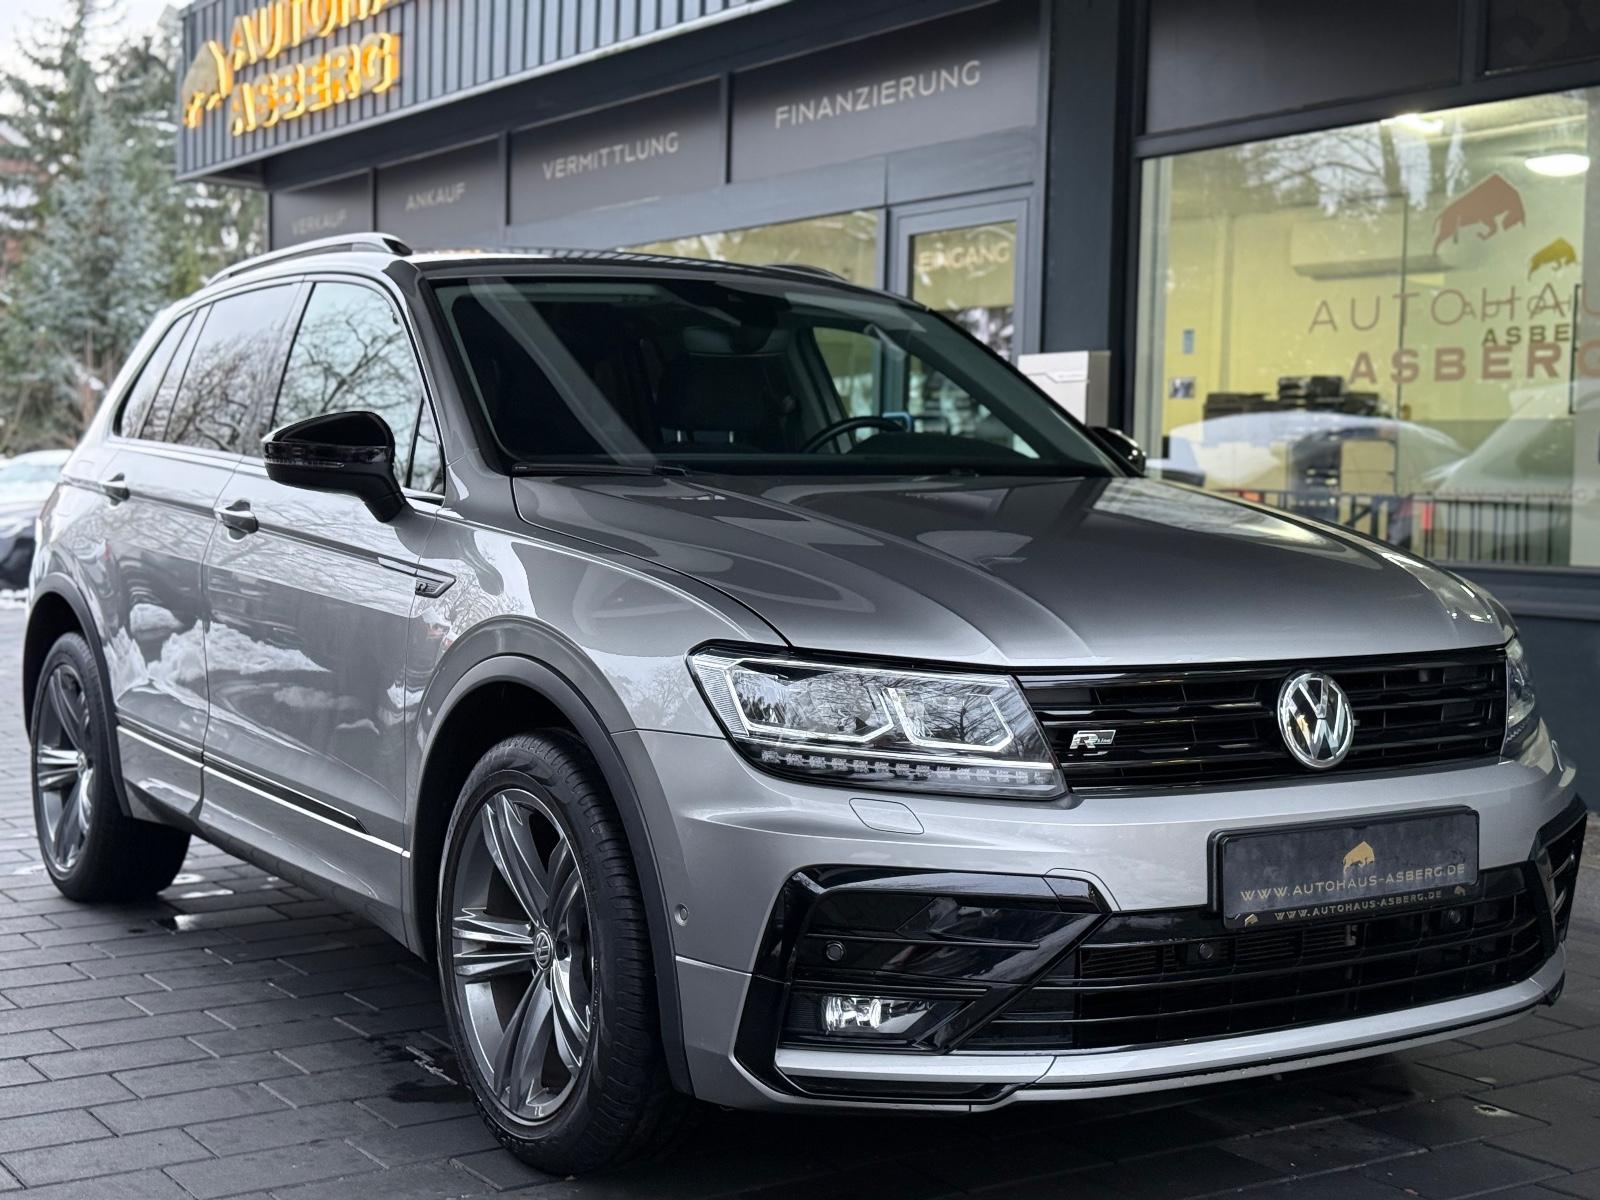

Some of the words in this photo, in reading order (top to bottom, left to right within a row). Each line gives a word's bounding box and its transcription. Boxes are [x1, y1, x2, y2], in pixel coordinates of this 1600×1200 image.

[775, 60, 981, 129] FINANZIERUNG
[542, 131, 680, 181] VERMITTLUNG
[404, 182, 467, 211] ANKAUF
[1240, 863, 1465, 902] WWW.AUTOHAUS-ASBERG.DE
[1274, 890, 1442, 921] WWW.AUTOHAUS-ASBERG.DE
